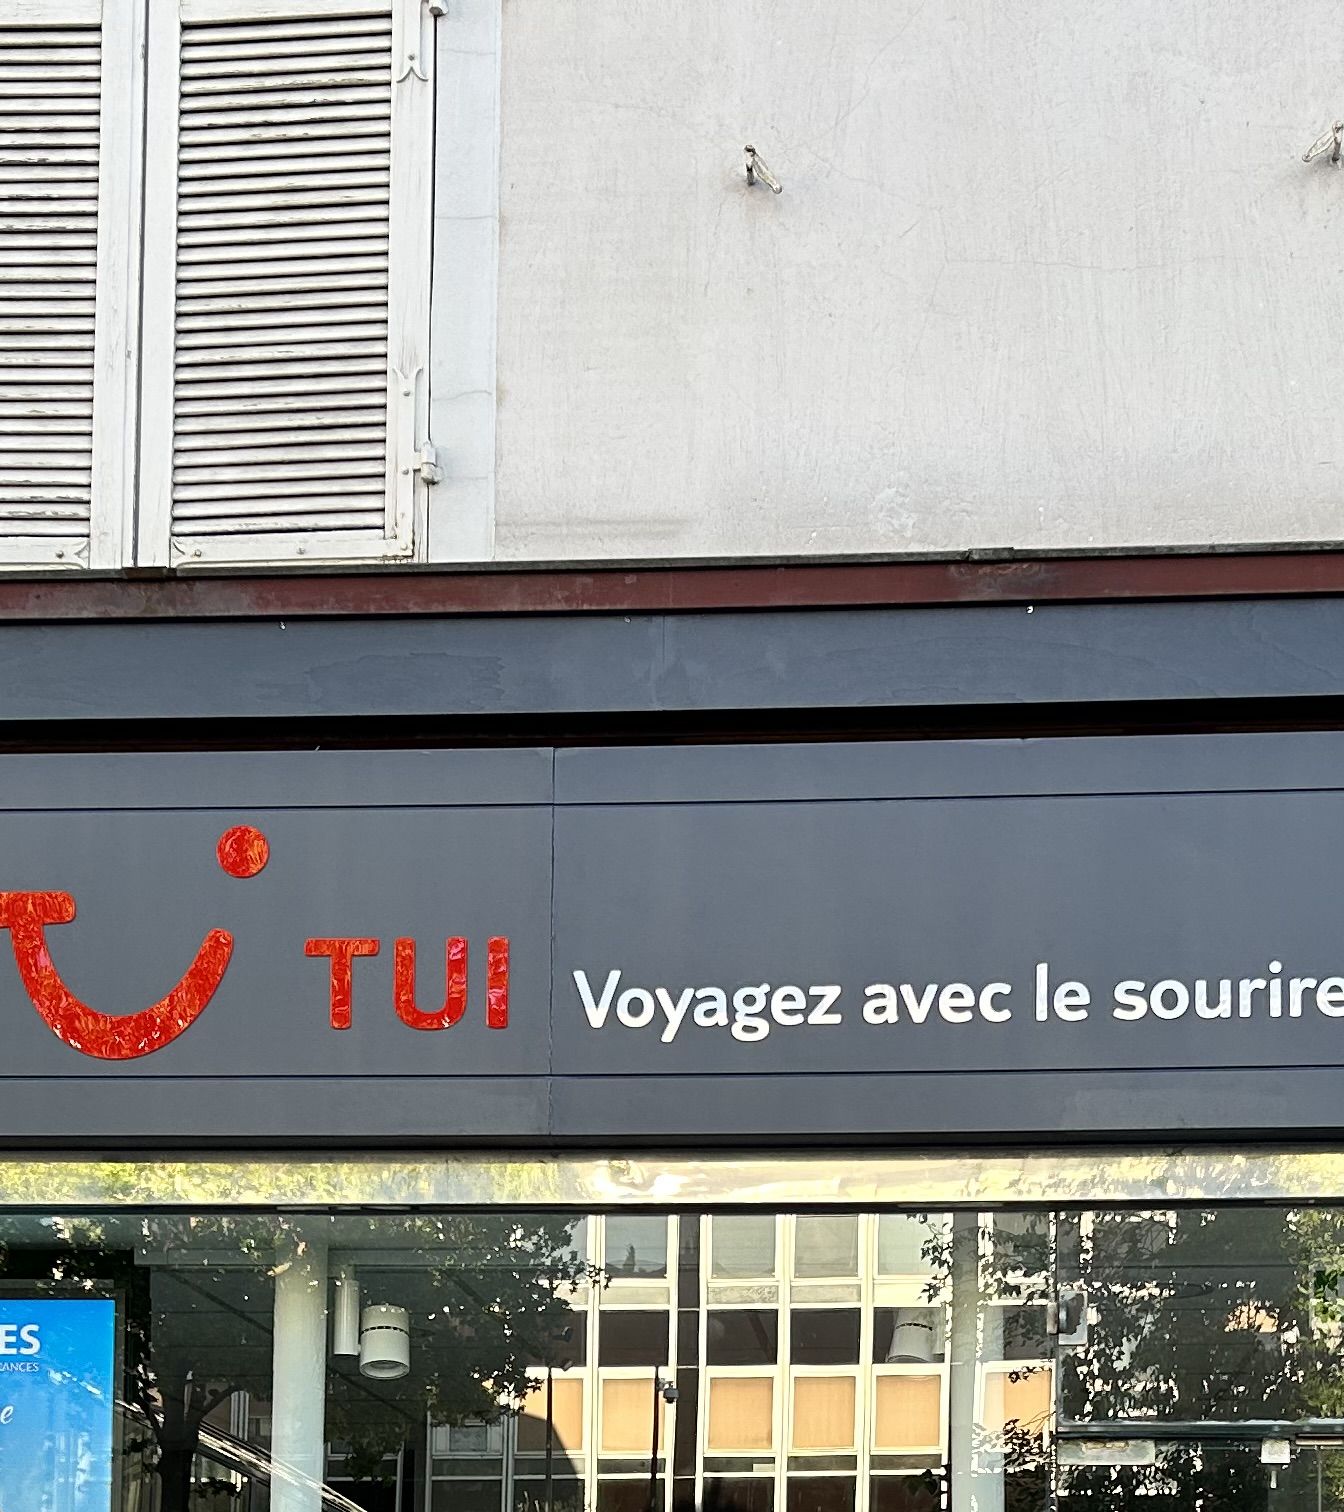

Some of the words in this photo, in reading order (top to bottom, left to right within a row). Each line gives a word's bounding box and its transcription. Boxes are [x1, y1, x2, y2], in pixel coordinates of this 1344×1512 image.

[305, 936, 509, 1030] TUI
[573, 967, 842, 1043] Voyagez
[862, 974, 1014, 1024] avec
[1034, 962, 1091, 1022] le
